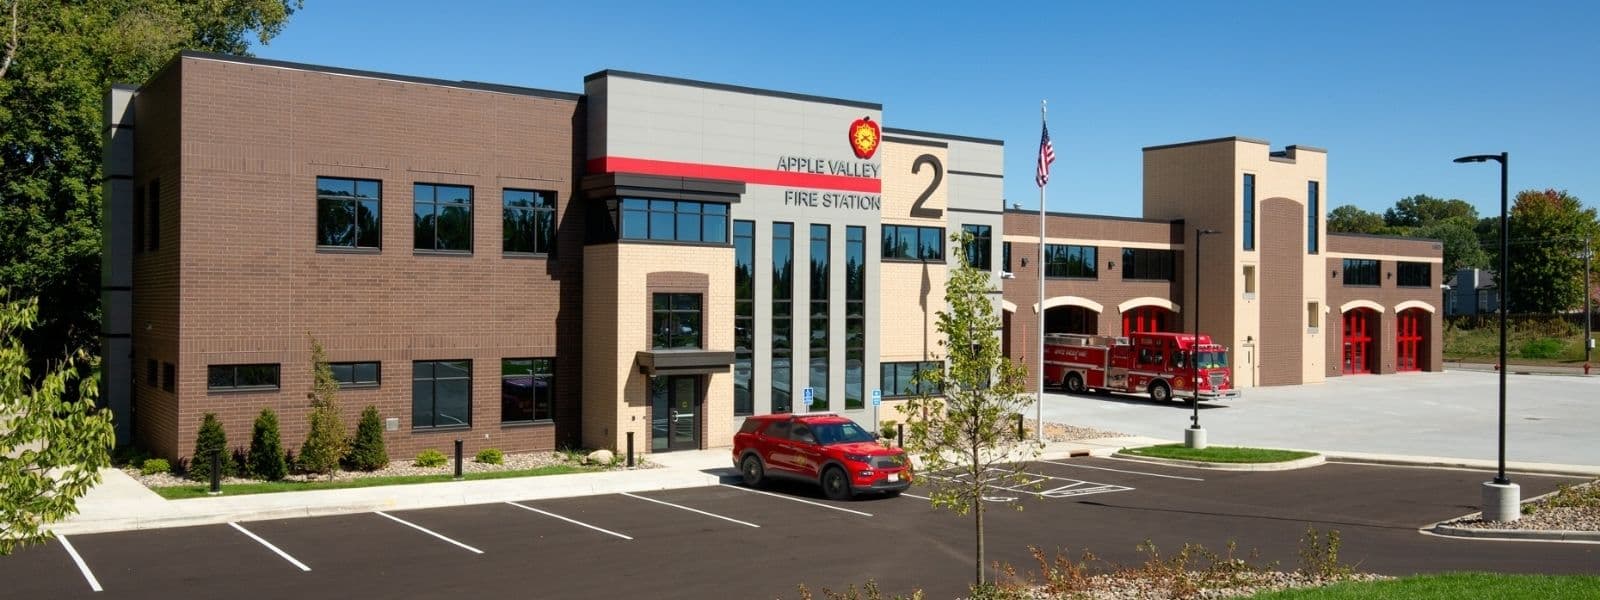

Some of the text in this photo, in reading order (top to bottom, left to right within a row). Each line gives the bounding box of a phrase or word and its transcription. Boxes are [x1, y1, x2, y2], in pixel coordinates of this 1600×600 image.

[777, 156, 880, 178] APPLE VALLEY
[911, 154, 943, 218] 2
[785, 191, 880, 210] FIRE STATION
